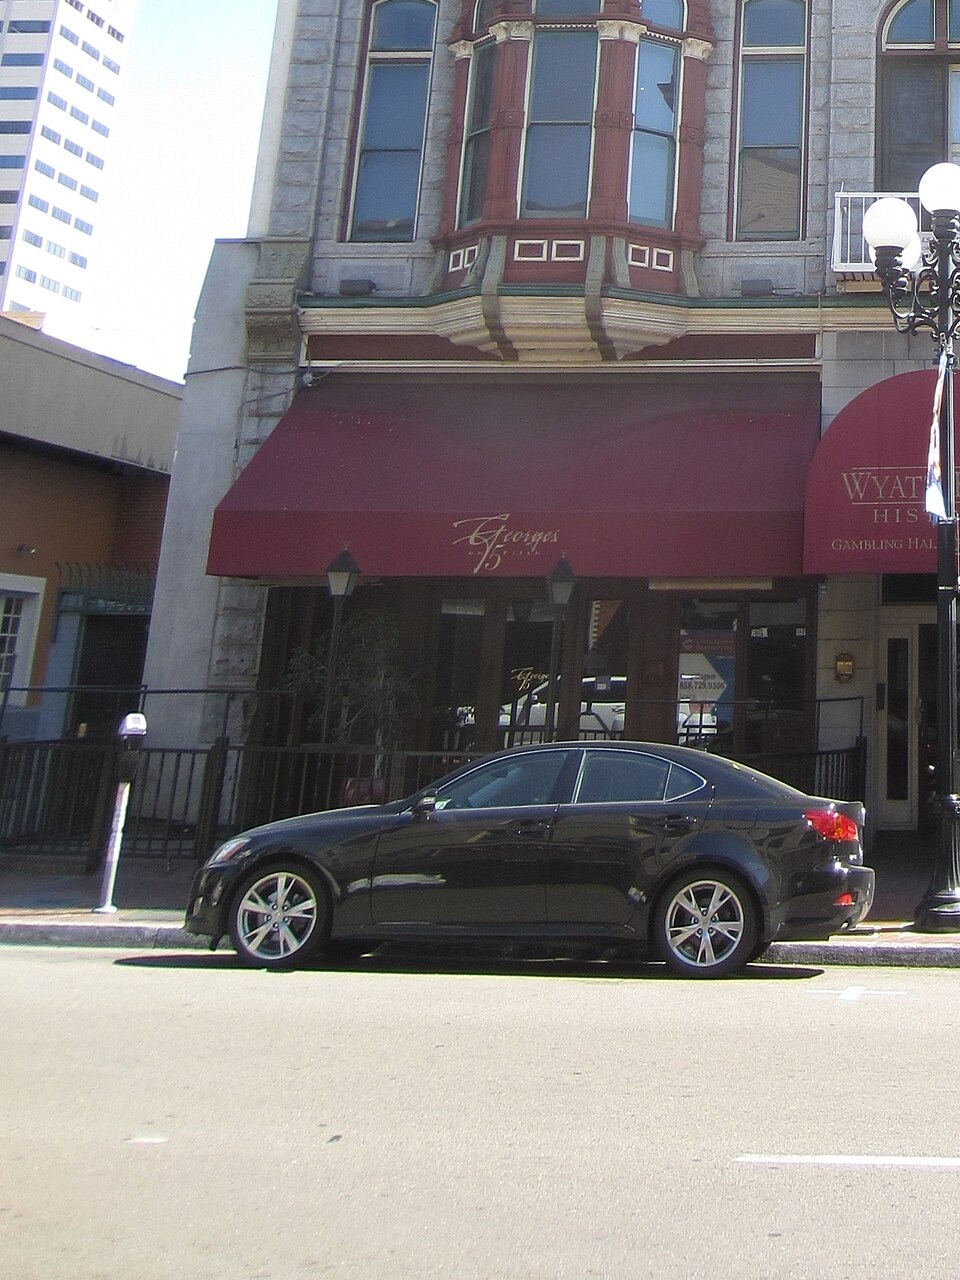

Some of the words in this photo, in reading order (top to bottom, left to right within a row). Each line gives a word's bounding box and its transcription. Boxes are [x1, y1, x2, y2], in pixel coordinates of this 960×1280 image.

[842, 471, 927, 501] WYAT
[831, 537, 904, 551] GAMBLING
[908, 536, 937, 550] HAL
